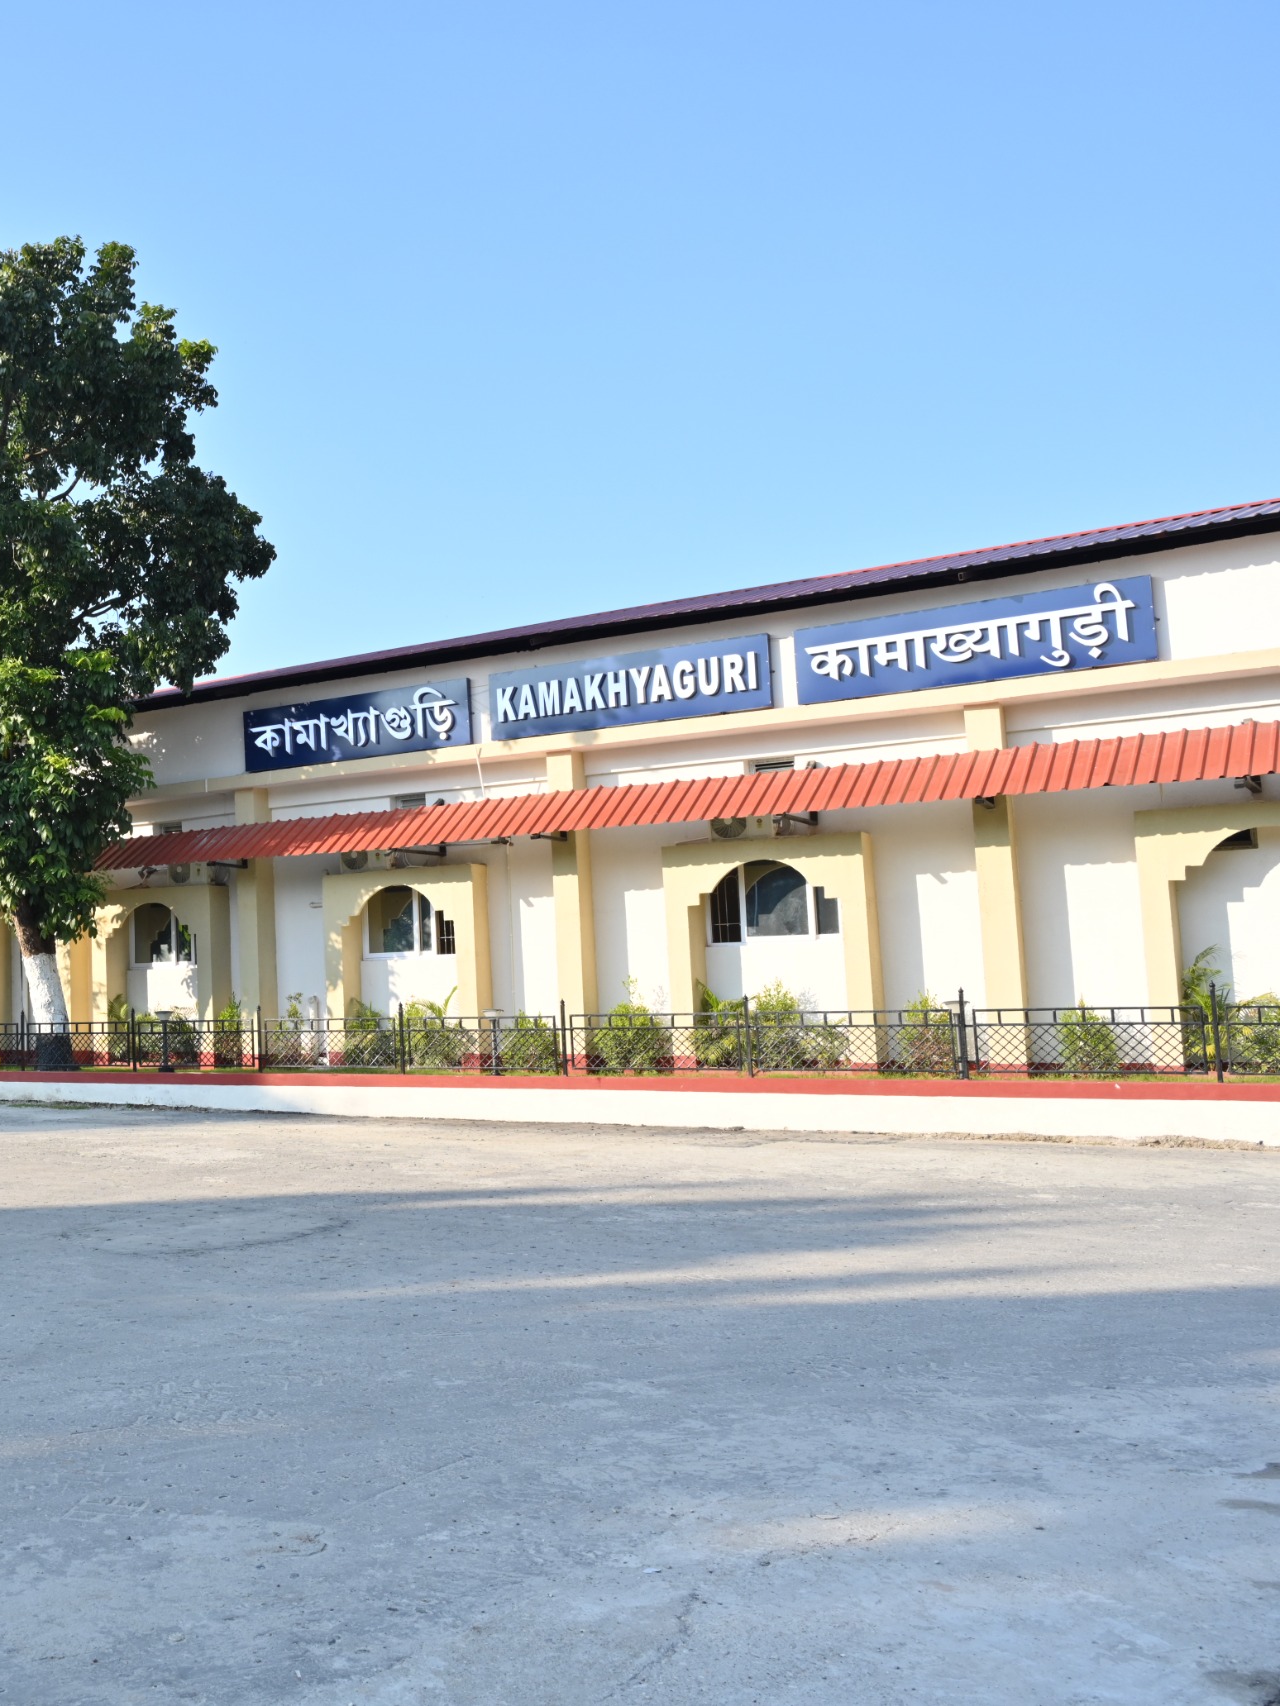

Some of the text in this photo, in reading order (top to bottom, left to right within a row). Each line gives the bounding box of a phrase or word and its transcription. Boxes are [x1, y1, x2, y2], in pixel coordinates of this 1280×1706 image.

[804, 583, 1135, 680] कामाख्यागुड़ी
[250, 687, 457, 757] কামাখ্যাগুড়ি
[496, 651, 759, 722] KAMAKHYAGURI
